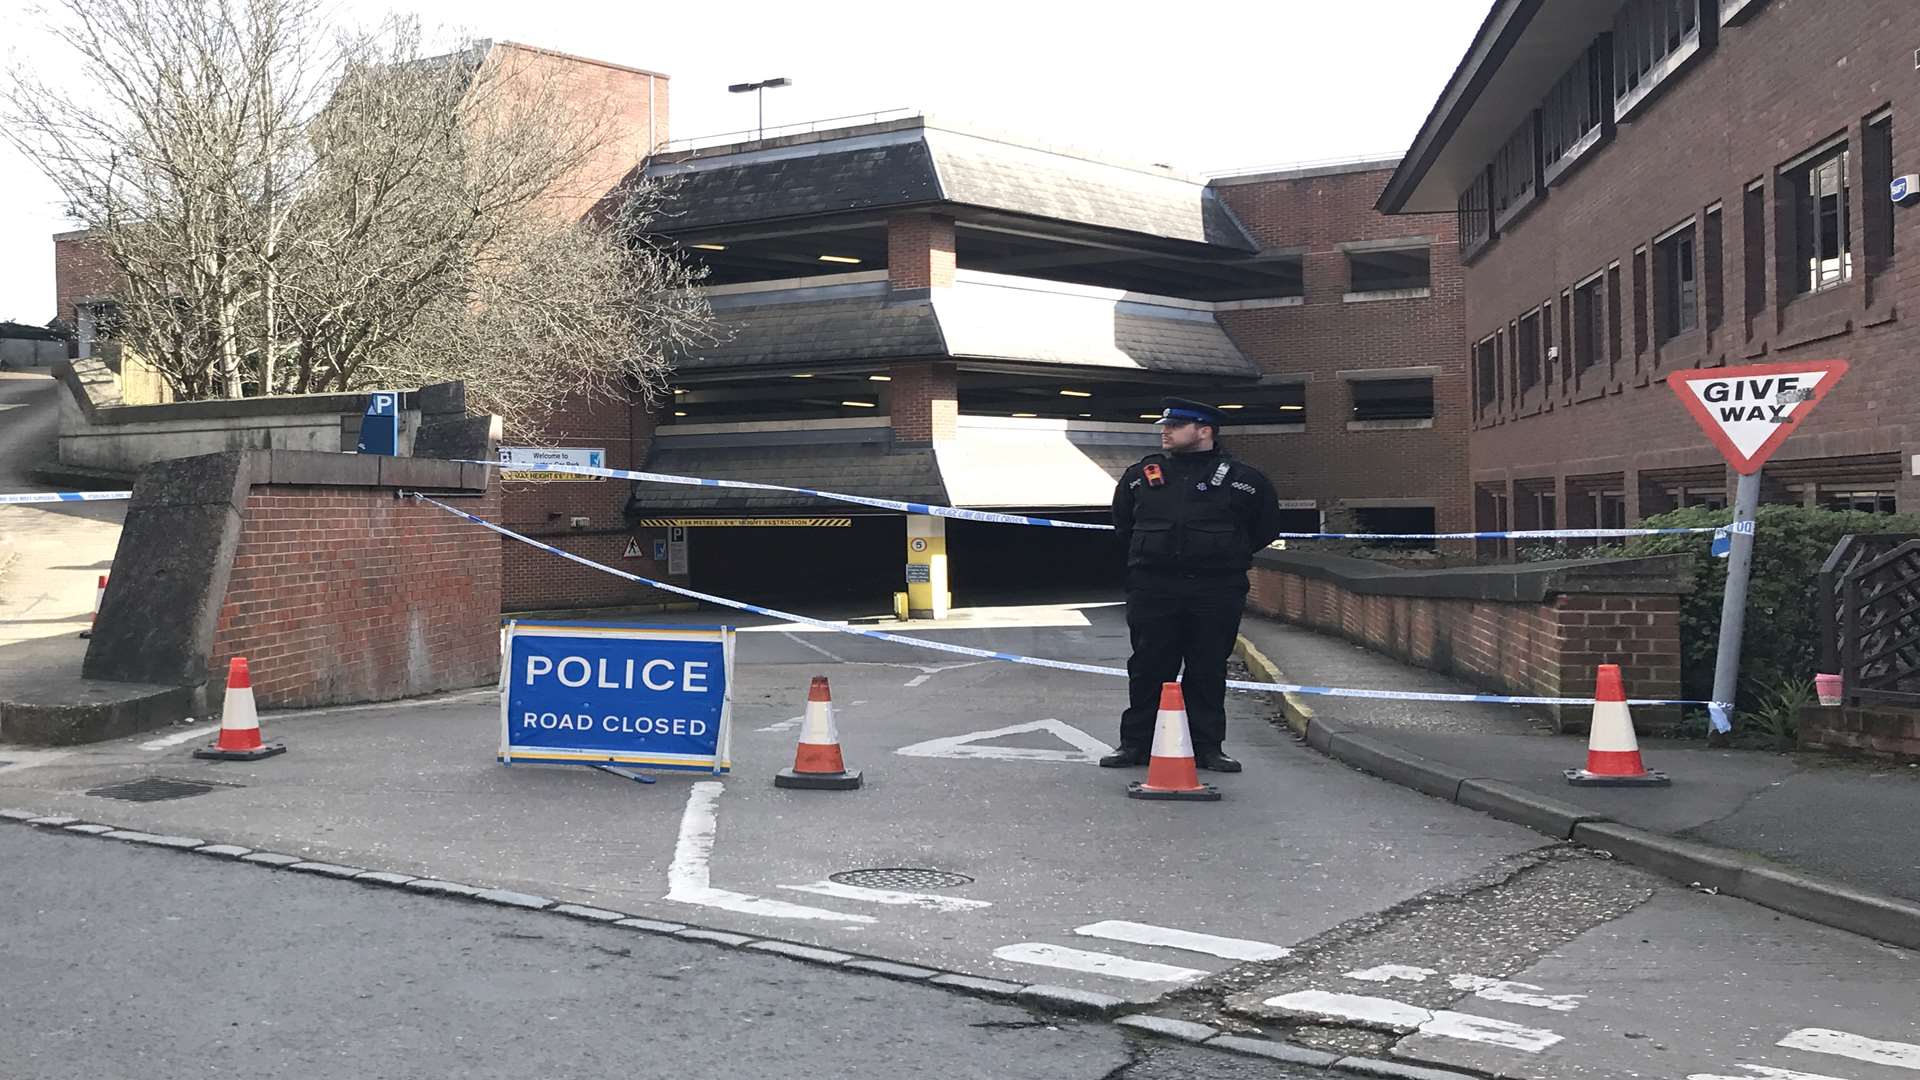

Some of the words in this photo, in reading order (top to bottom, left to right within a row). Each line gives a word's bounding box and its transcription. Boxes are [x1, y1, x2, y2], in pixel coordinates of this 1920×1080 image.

[1703, 377, 1800, 403] GIVE
[377, 396, 392, 413] P
[1720, 405, 1786, 423] WAY
[533, 452, 561, 460] Welcome
[562, 452, 569, 460] to
[674, 528, 682, 541] P
[915, 541, 923, 549] 5
[526, 655, 709, 692] POLICE
[524, 712, 593, 730] ROAD
[603, 715, 706, 735] CLOSED
